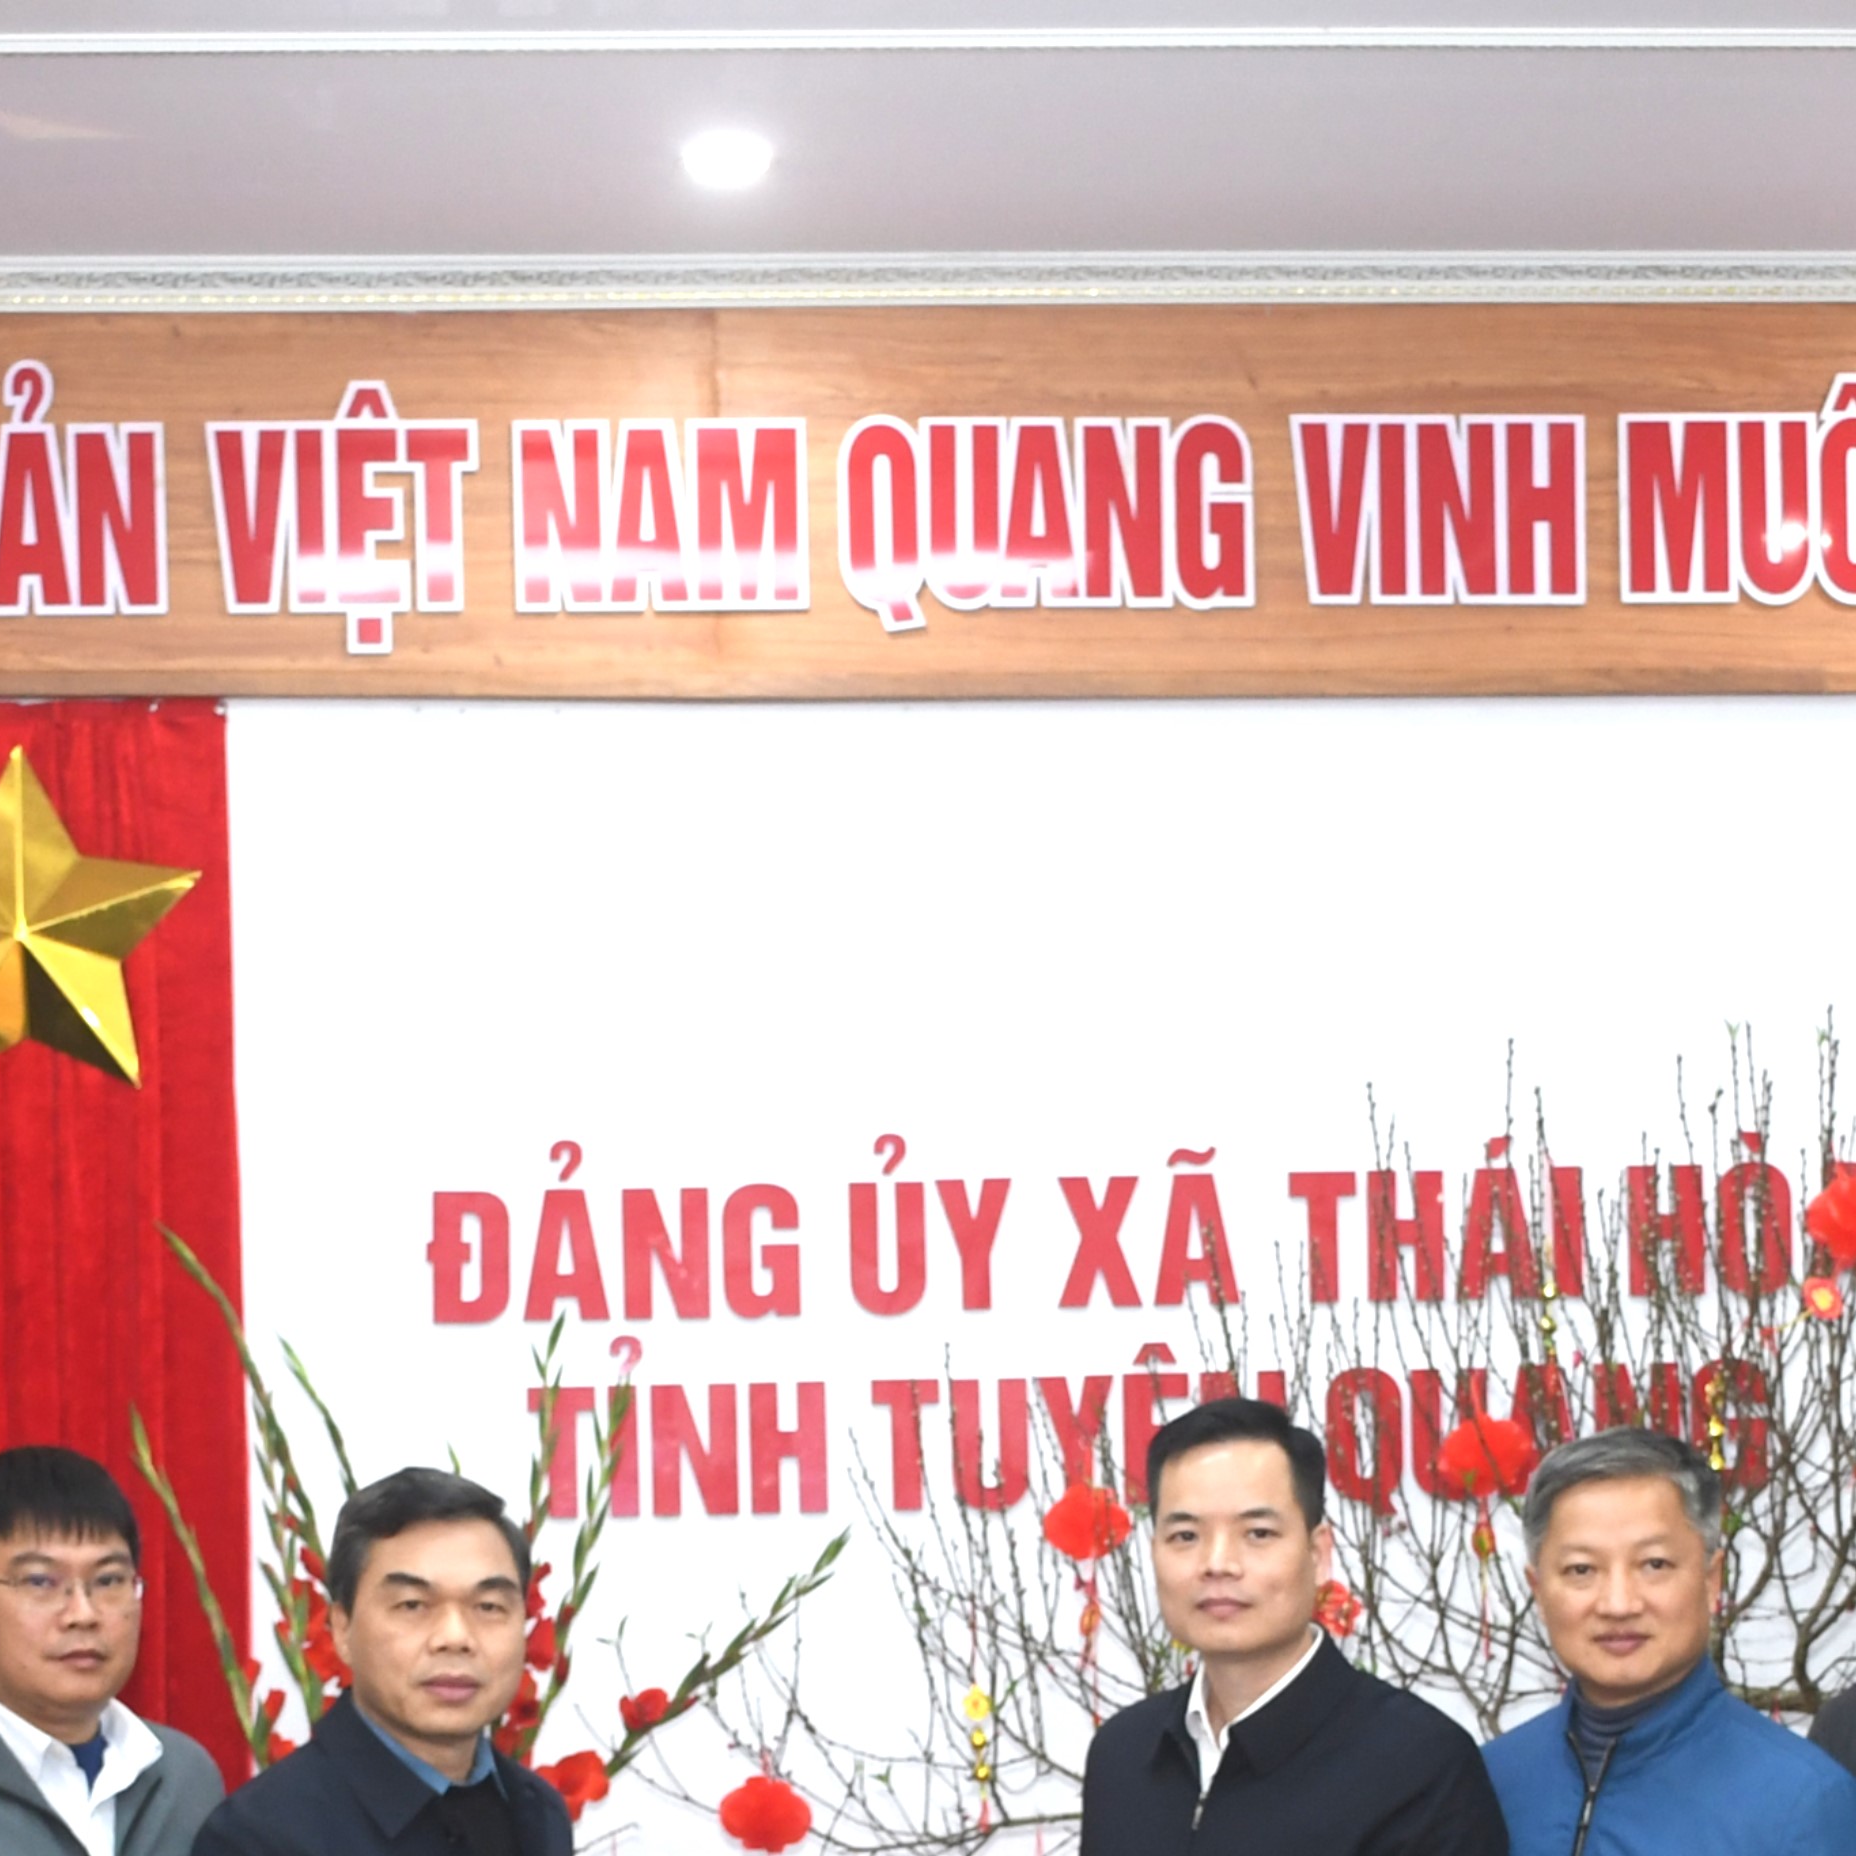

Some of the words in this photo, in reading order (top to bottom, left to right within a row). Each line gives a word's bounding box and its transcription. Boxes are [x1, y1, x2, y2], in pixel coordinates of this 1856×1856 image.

[206, 380, 480, 655] VIỆT
[512, 416, 809, 612] NAM
[837, 413, 1256, 632] QUANG
[1291, 413, 1588, 606] VINH
[426, 1140, 802, 1325] ĐẢNG
[848, 1134, 1010, 1315] ỦY
[1059, 1146, 1240, 1309] XÃ
[1288, 1136, 1584, 1303] THÁI
[527, 1335, 828, 1519] TỈNH
[871, 1342, 1286, 1513] TUYÊ
